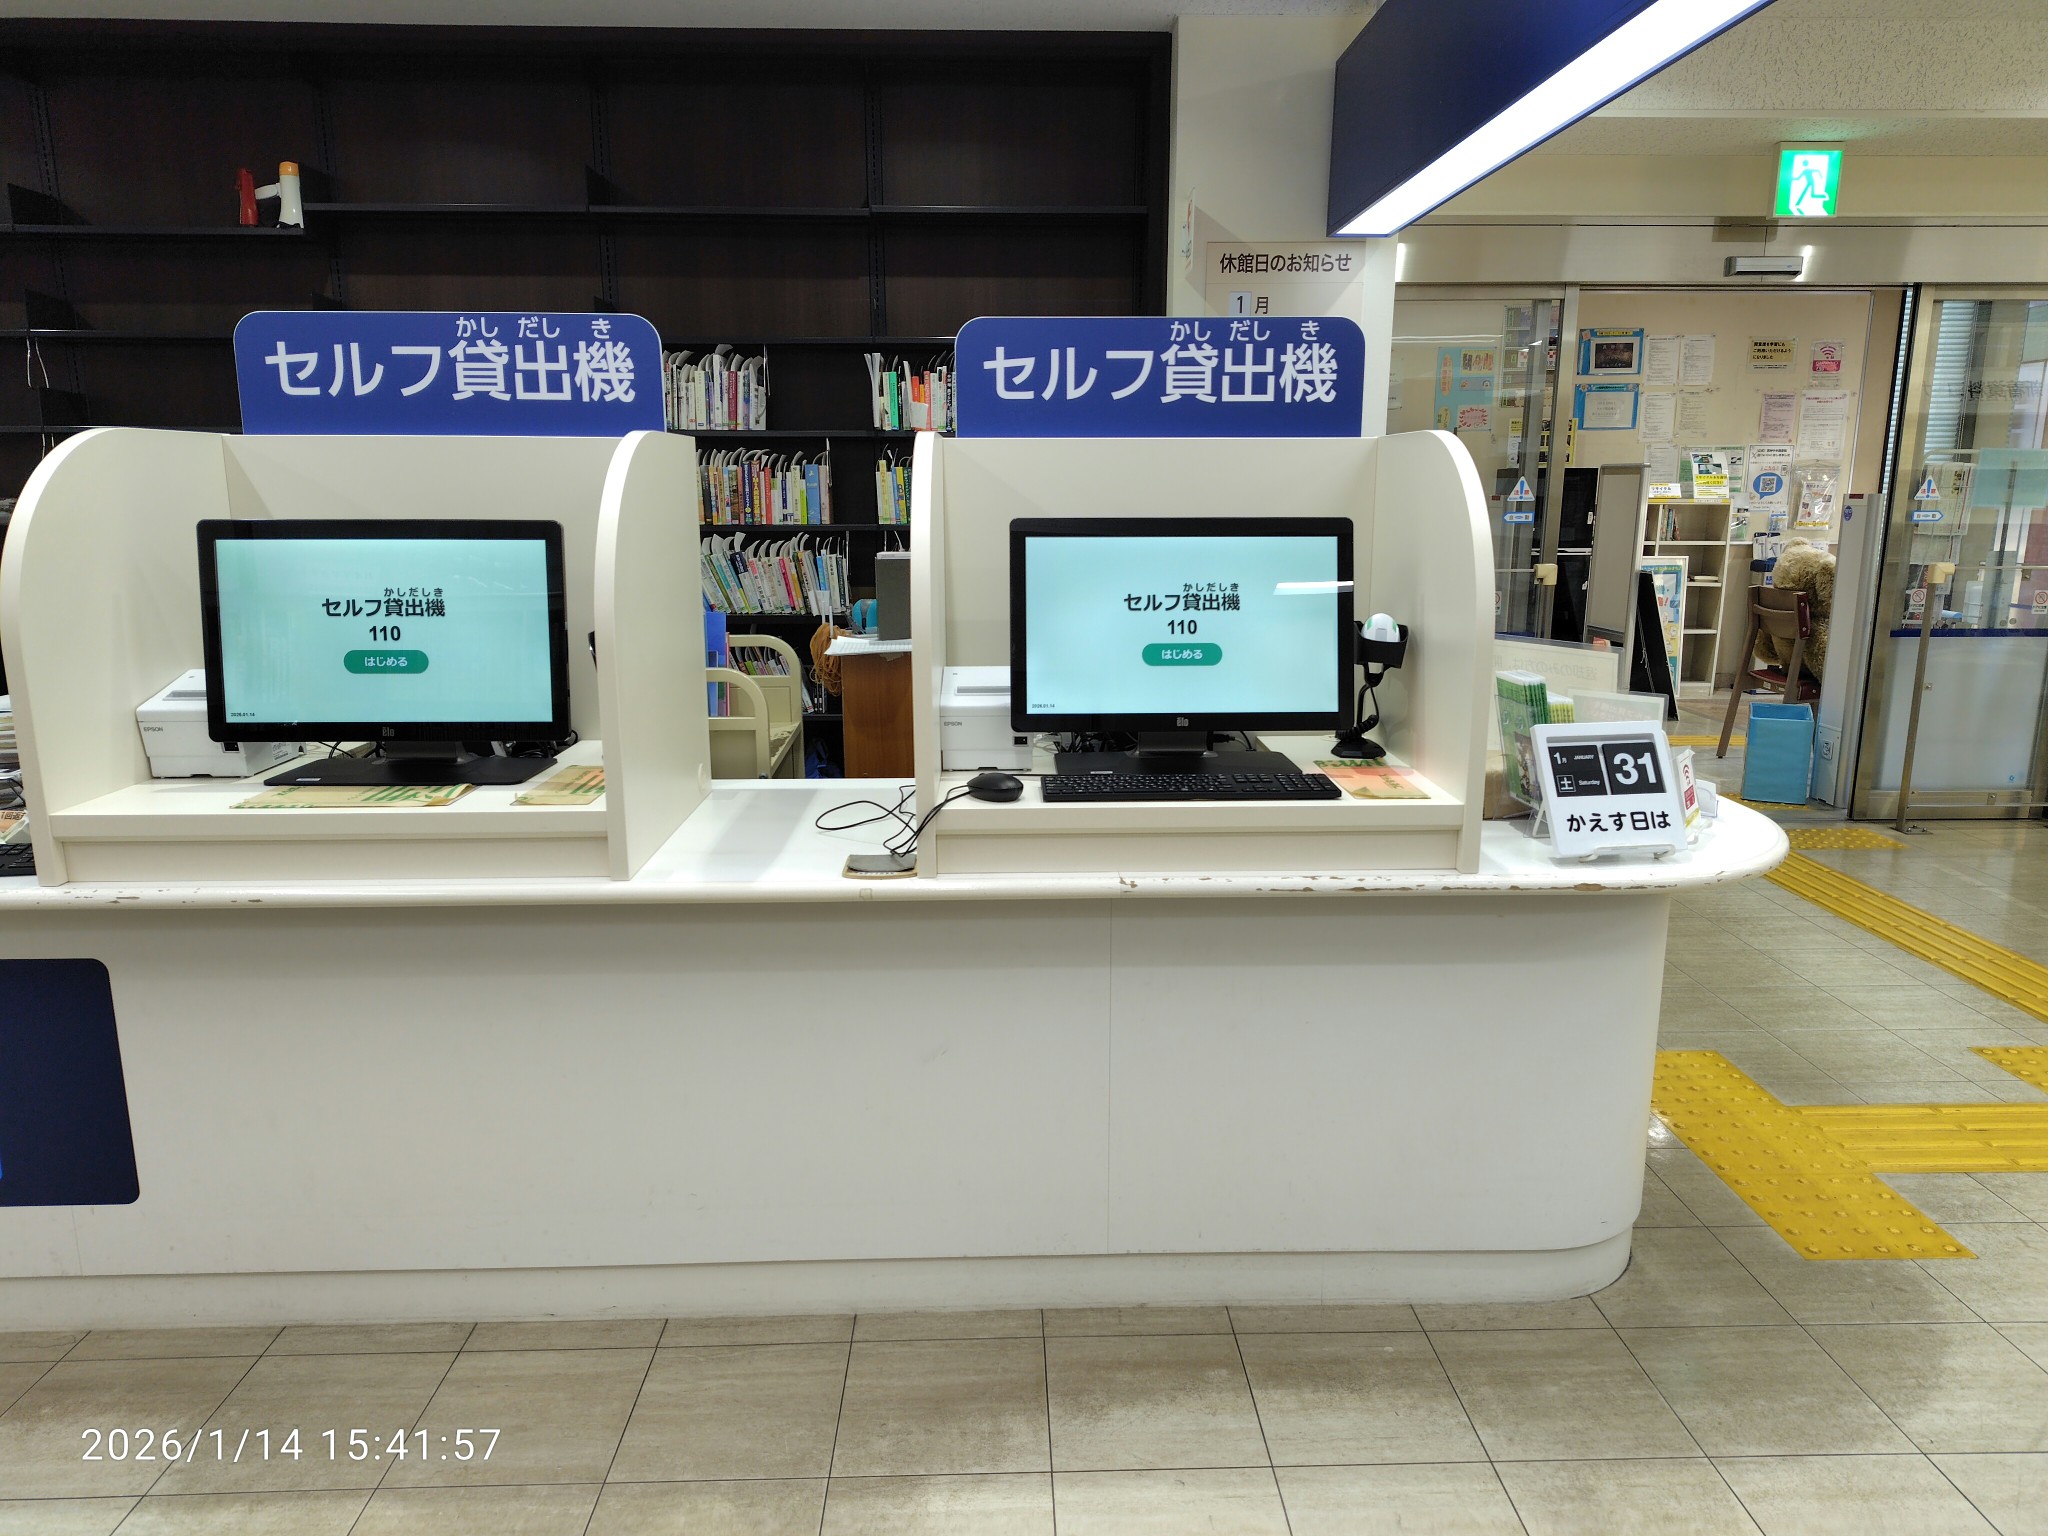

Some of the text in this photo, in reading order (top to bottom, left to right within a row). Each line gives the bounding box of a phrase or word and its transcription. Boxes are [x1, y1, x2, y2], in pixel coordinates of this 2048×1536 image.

[1219, 253, 1352, 274] 休館日のお知らせ
[455, 316, 612, 339] かし だし き
[1170, 320, 1320, 342] かし だし き
[264, 338, 636, 403] セルフ貸出機
[983, 341, 1338, 404] セルフ貸出機
[383, 587, 444, 597] かしだしき
[1182, 582, 1240, 592] かしだしき
[321, 598, 446, 617] セルフ貸出機
[1123, 593, 1241, 612] セルフ貸出機
[369, 625, 401, 641] 110
[1167, 619, 1198, 635] 110
[364, 656, 408, 667] はじめる
[1161, 649, 1204, 660] はじめる
[1613, 752, 1657, 785] 31
[1560, 777, 1574, 790] 土
[1566, 810, 1671, 833] かえす日は
